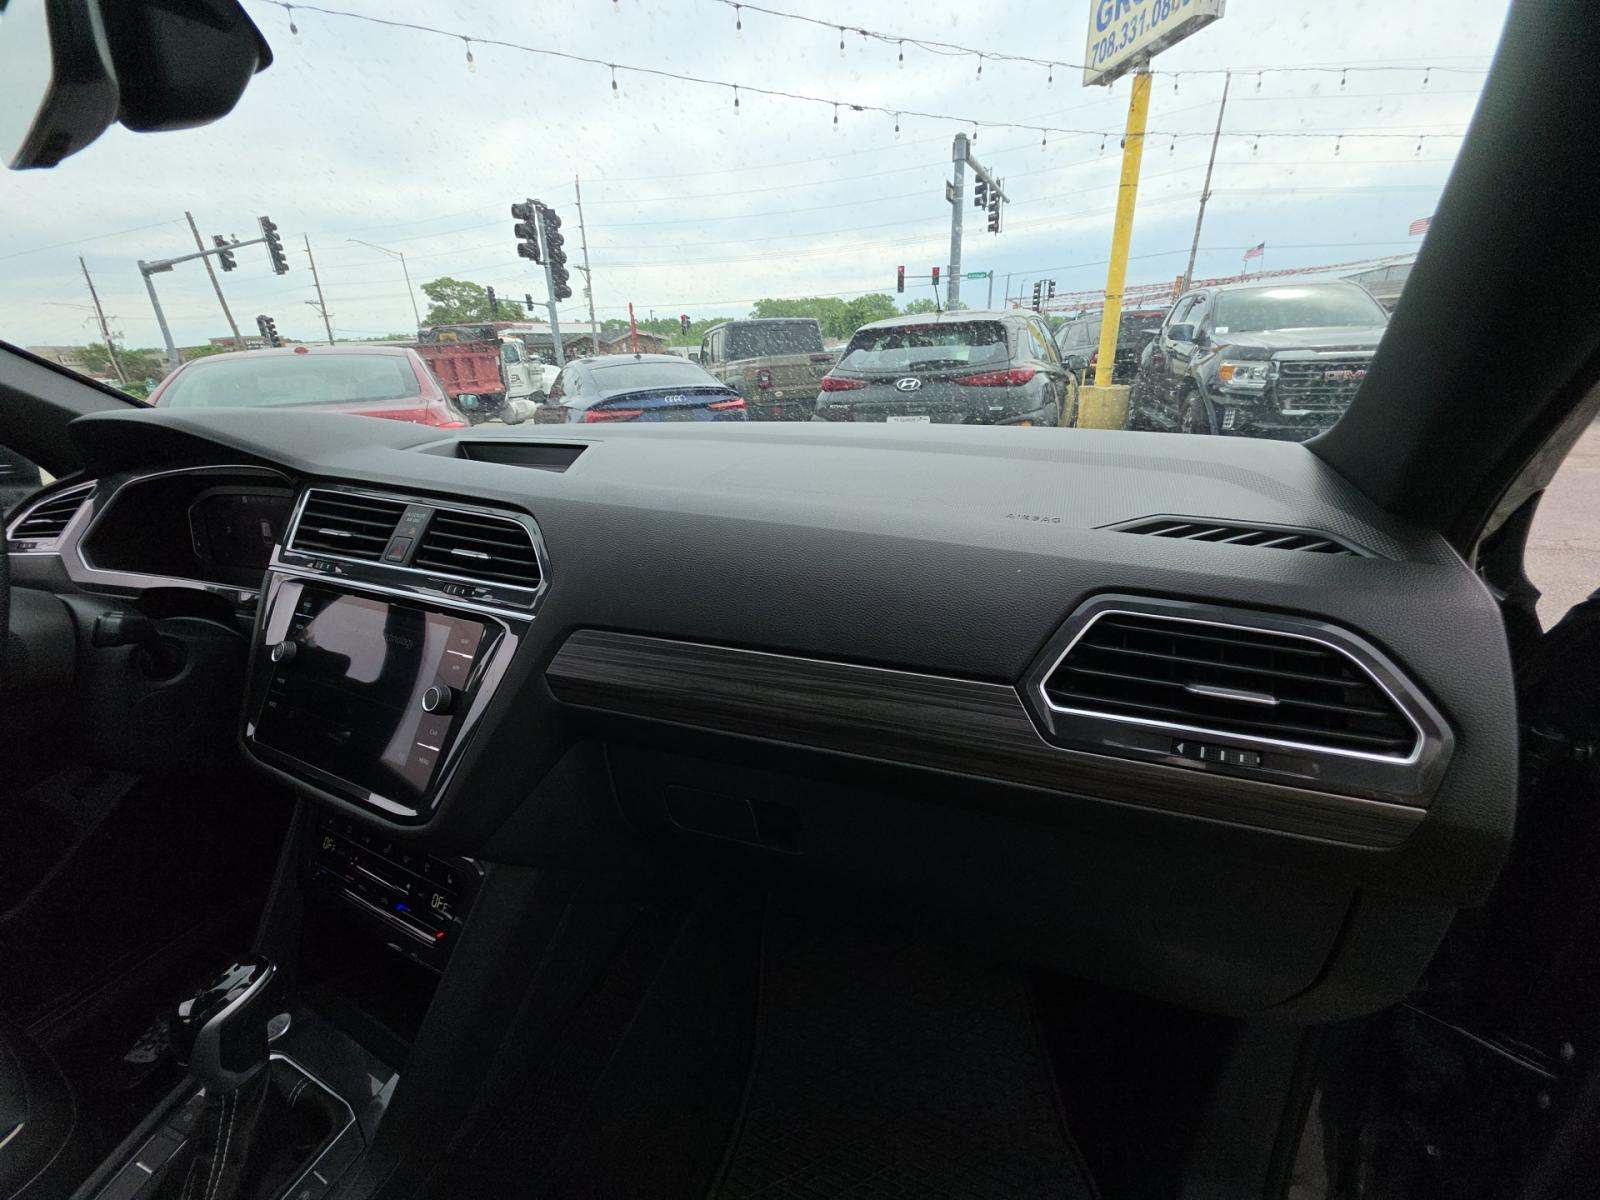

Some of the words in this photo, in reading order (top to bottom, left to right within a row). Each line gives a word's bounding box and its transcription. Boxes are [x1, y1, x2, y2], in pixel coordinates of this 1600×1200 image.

[1096, 0, 1144, 32] GR
[1092, 0, 1190, 66] 708.331.08
[1006, 513, 1061, 524] AIRBAG
[430, 893, 448, 911] OFF
